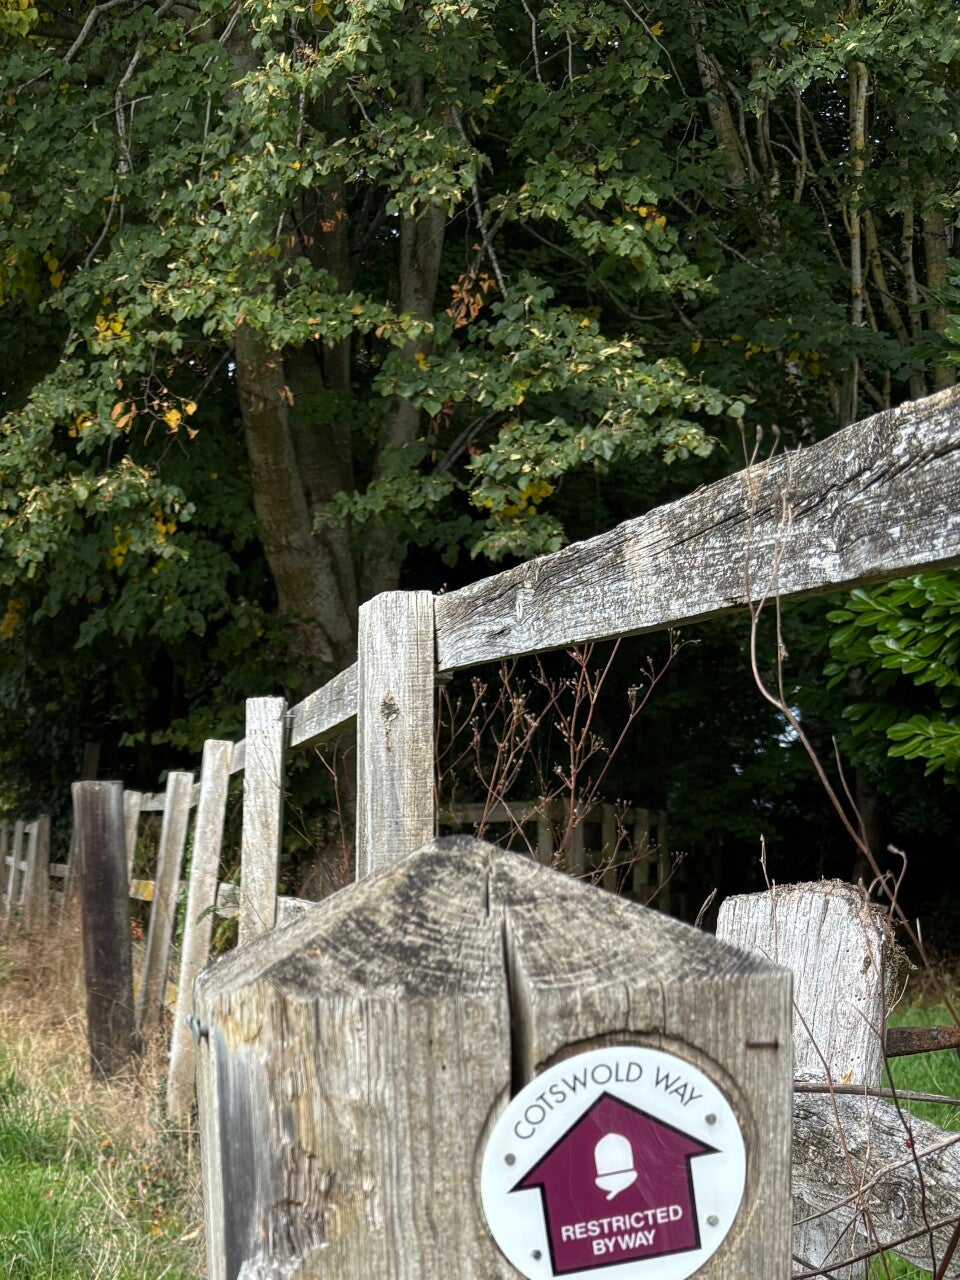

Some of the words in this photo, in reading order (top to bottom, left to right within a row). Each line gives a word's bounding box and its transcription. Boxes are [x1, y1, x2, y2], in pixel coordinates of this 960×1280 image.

[513, 1062, 643, 1140] COTSWOLD
[655, 1066, 703, 1107] WAY
[560, 1204, 683, 1242] RESTRICTED
[592, 1229, 656, 1256] BYWAY
